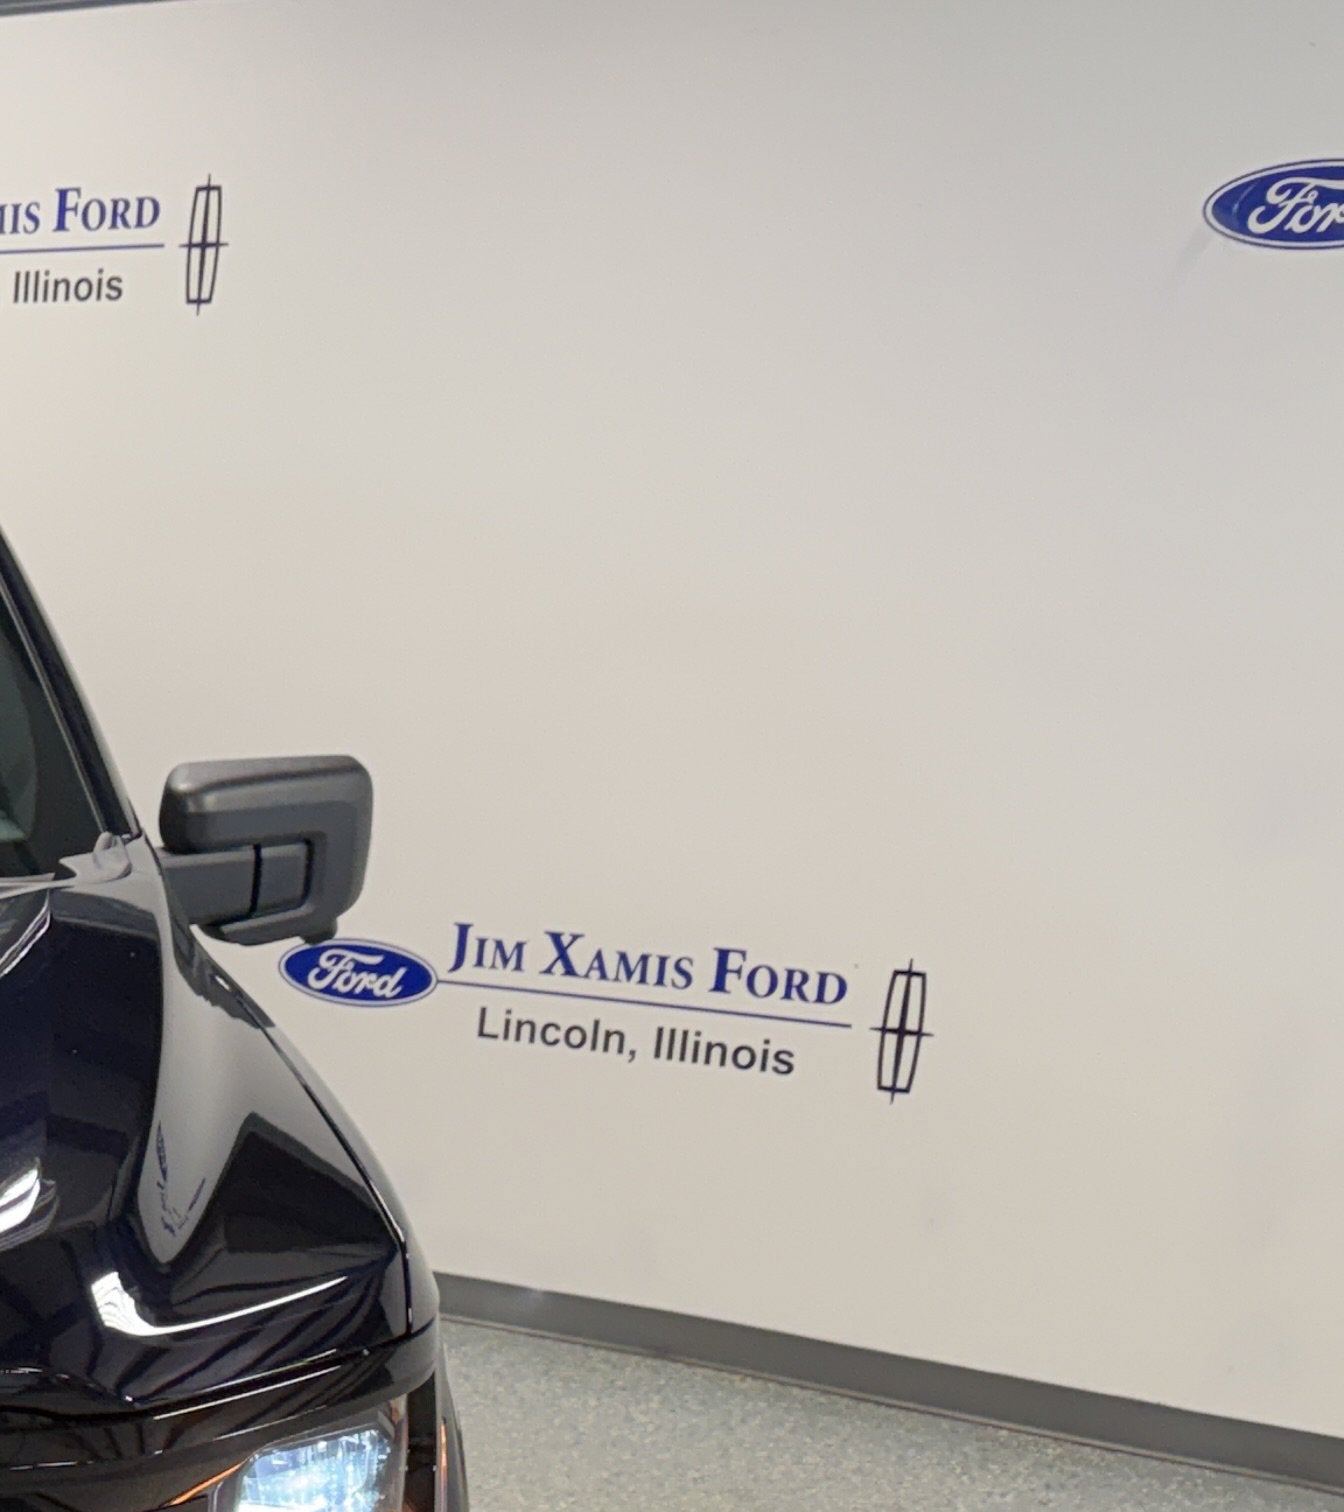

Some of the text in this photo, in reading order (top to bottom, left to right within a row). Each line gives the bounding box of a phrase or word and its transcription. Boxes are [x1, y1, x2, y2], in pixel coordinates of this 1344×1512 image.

[52, 187, 161, 233] FORD
[1248, 177, 1344, 234] For
[13, 268, 123, 304] Illinois
[307, 948, 406, 1000] Ford
[447, 922, 848, 1005] JIM XAMIS FORD
[477, 1006, 795, 1076] Lincoln, Illinois
